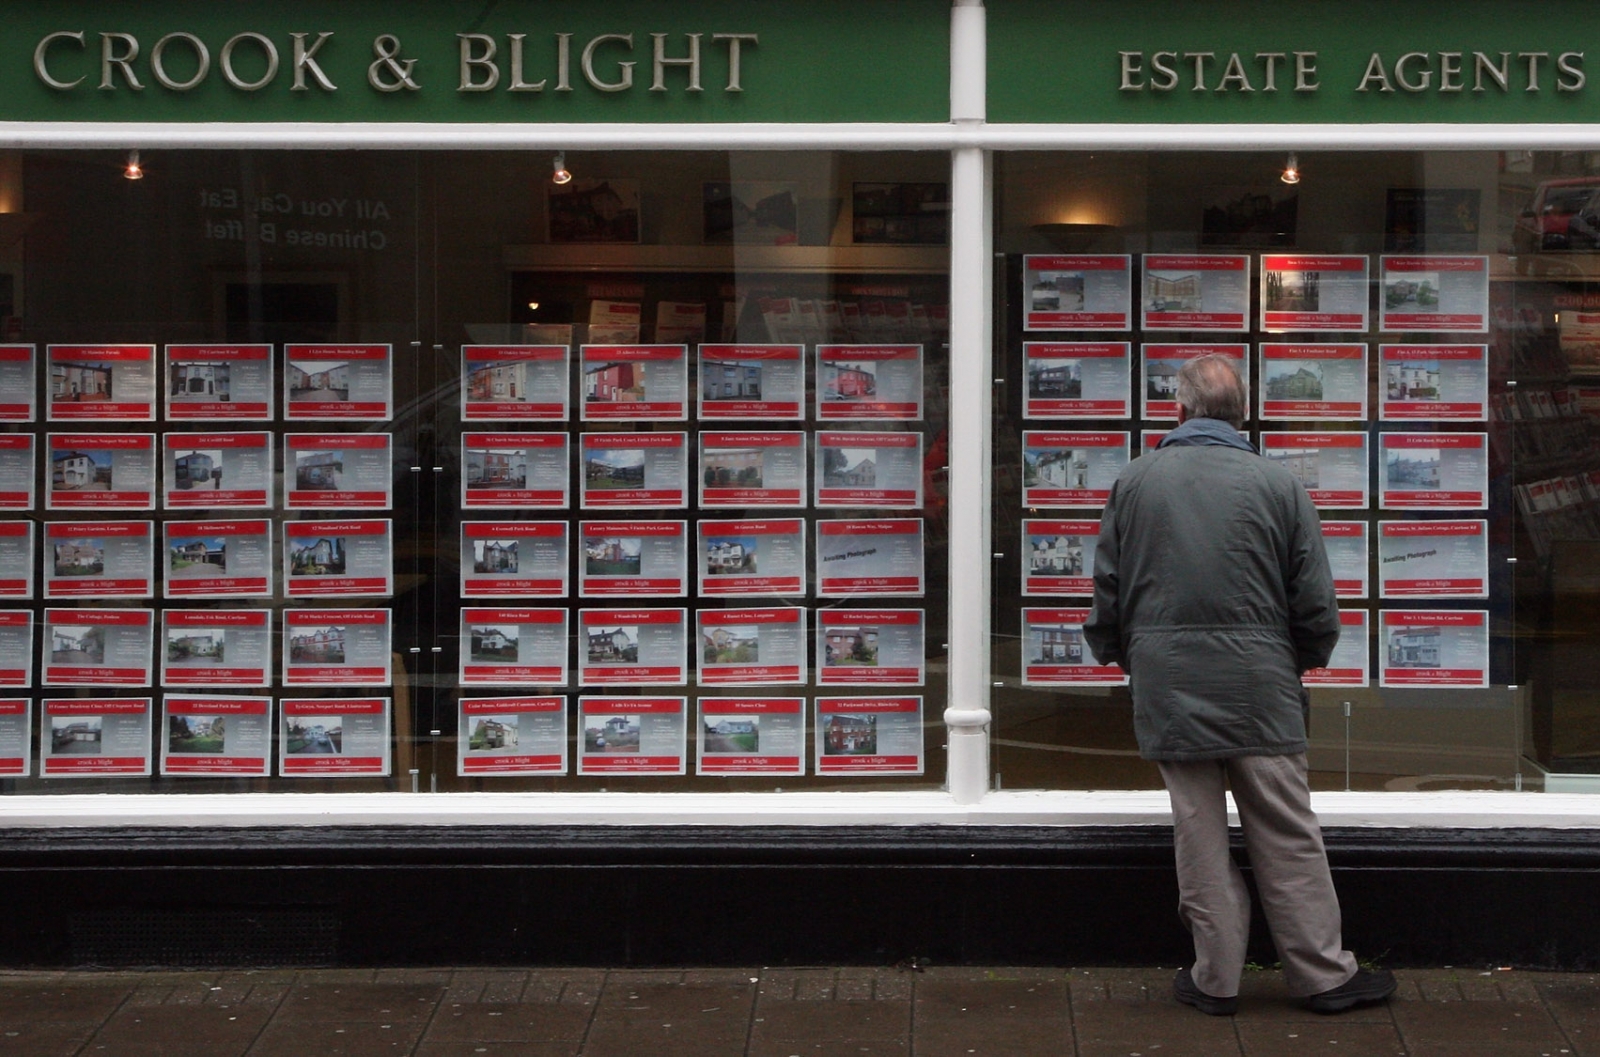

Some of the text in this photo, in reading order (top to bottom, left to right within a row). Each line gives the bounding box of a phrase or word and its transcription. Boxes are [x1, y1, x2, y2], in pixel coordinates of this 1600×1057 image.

[33, 30, 760, 92] CROOK & BLIGHT
[1118, 50, 1586, 92] ESTATE AGENTS
